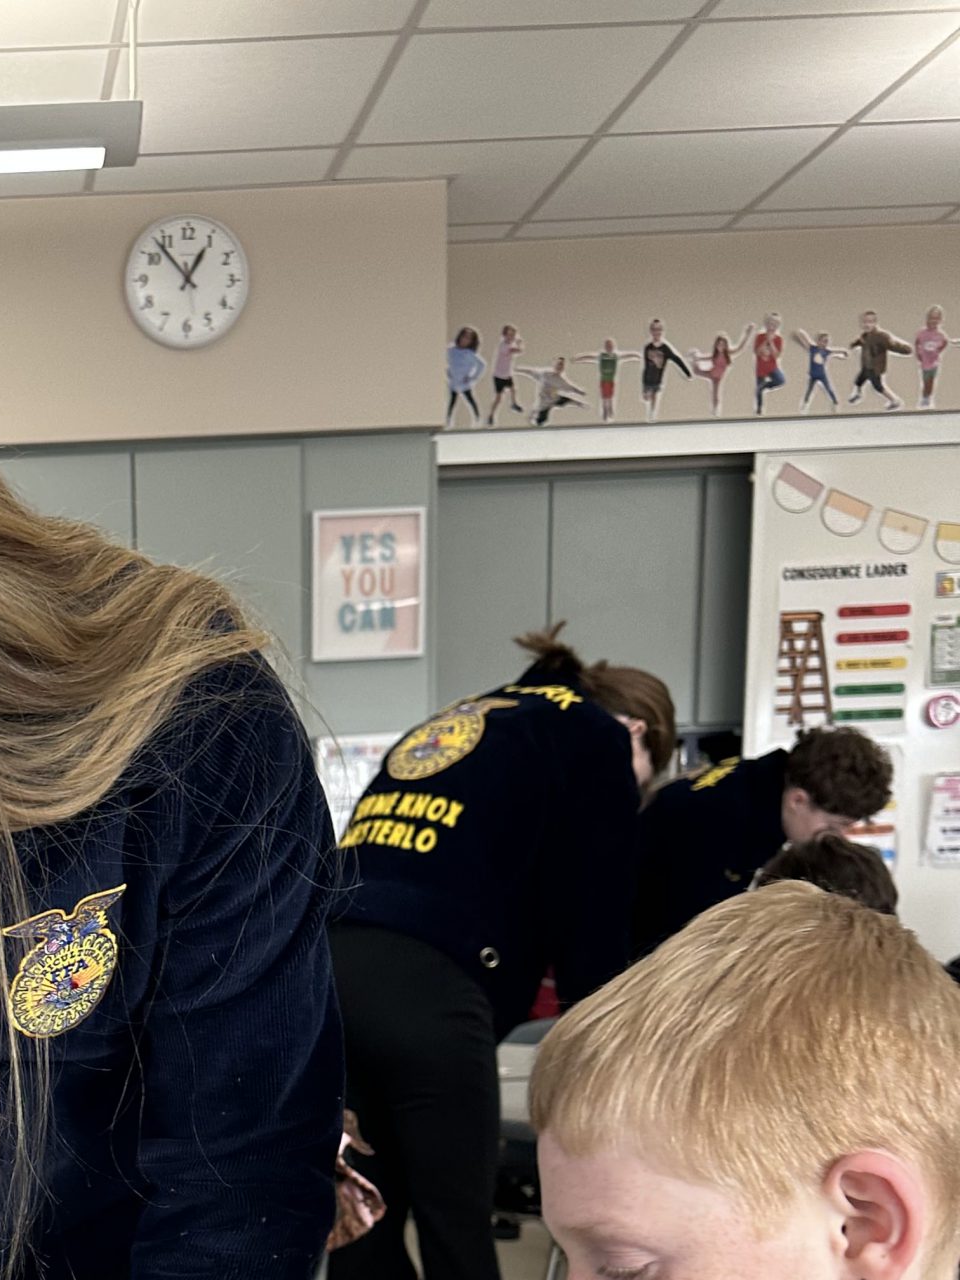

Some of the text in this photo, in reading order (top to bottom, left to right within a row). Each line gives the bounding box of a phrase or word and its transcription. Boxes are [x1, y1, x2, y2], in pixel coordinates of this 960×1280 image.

[181, 226, 196, 241] 12
[206, 234, 213, 248] 1
[147, 251, 162, 266] 10
[139, 273, 149, 289] 9
[225, 273, 236, 289] 3
[143, 295, 155, 309] 8
[159, 312, 171, 332] 7
[181, 319, 192, 334] 6
[203, 312, 213, 328] 5
[341, 532, 397, 565] YES
[783, 563, 908, 582] CONSEQUENCE LADDER
[341, 567, 395, 598] YOU
[337, 602, 397, 633] CAN
[394, 791, 464, 828] KNOX
[51, 959, 89, 984] FFA
